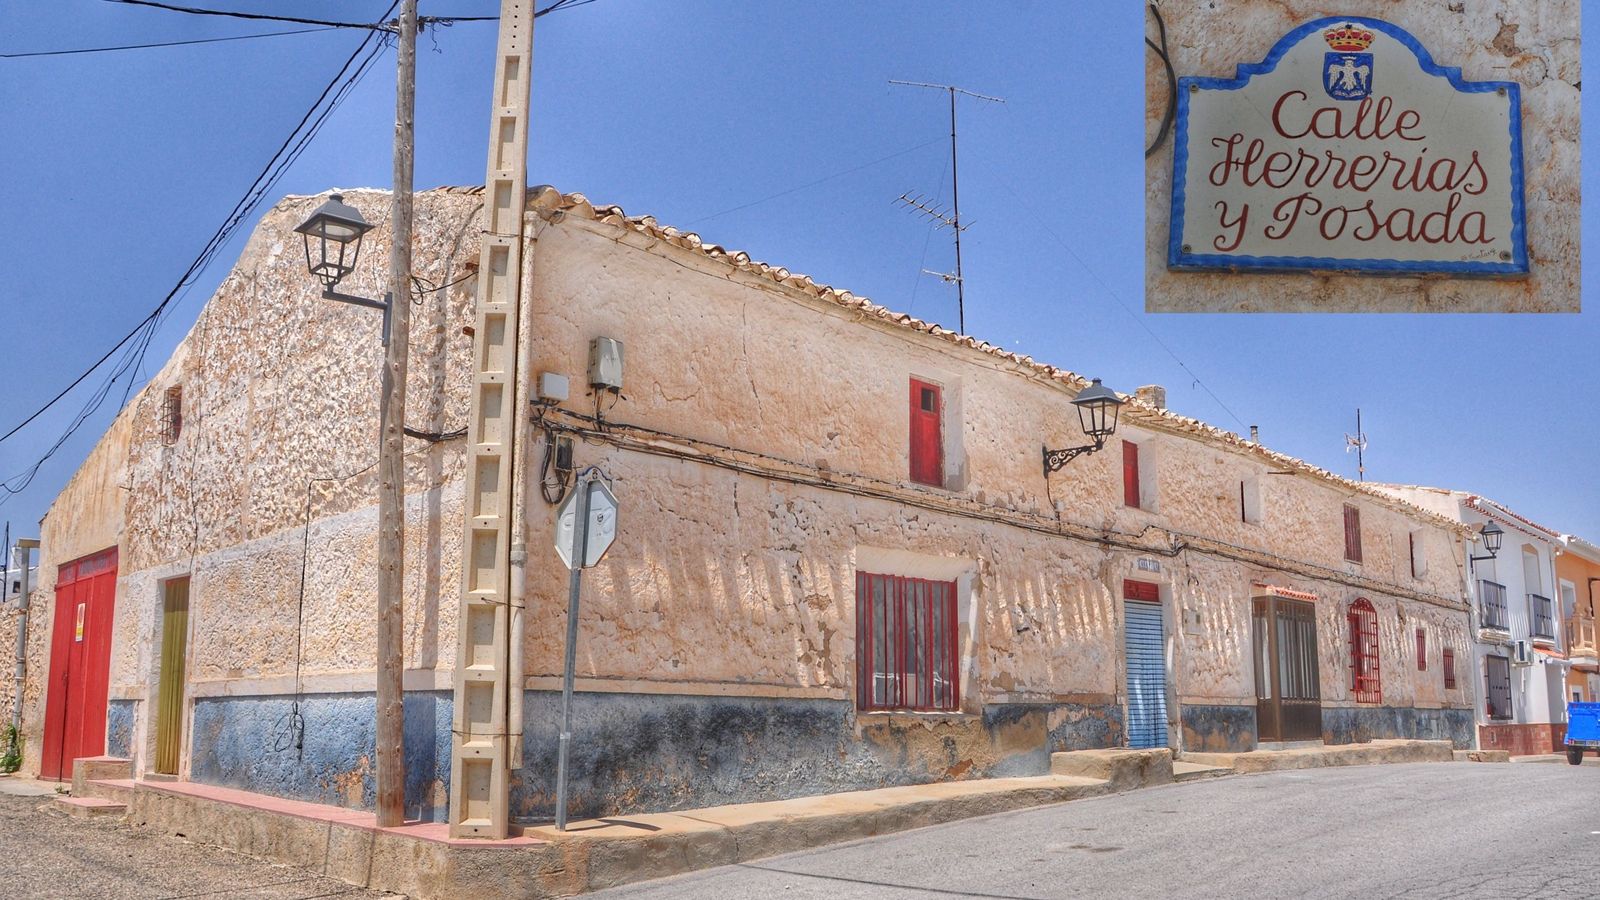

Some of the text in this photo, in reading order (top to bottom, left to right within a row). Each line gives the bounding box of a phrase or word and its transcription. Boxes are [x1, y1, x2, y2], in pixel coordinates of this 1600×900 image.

[1271, 90, 1425, 141] Calle
[1208, 133, 1489, 195] Herrerías
[1212, 192, 1495, 252] y Posada
